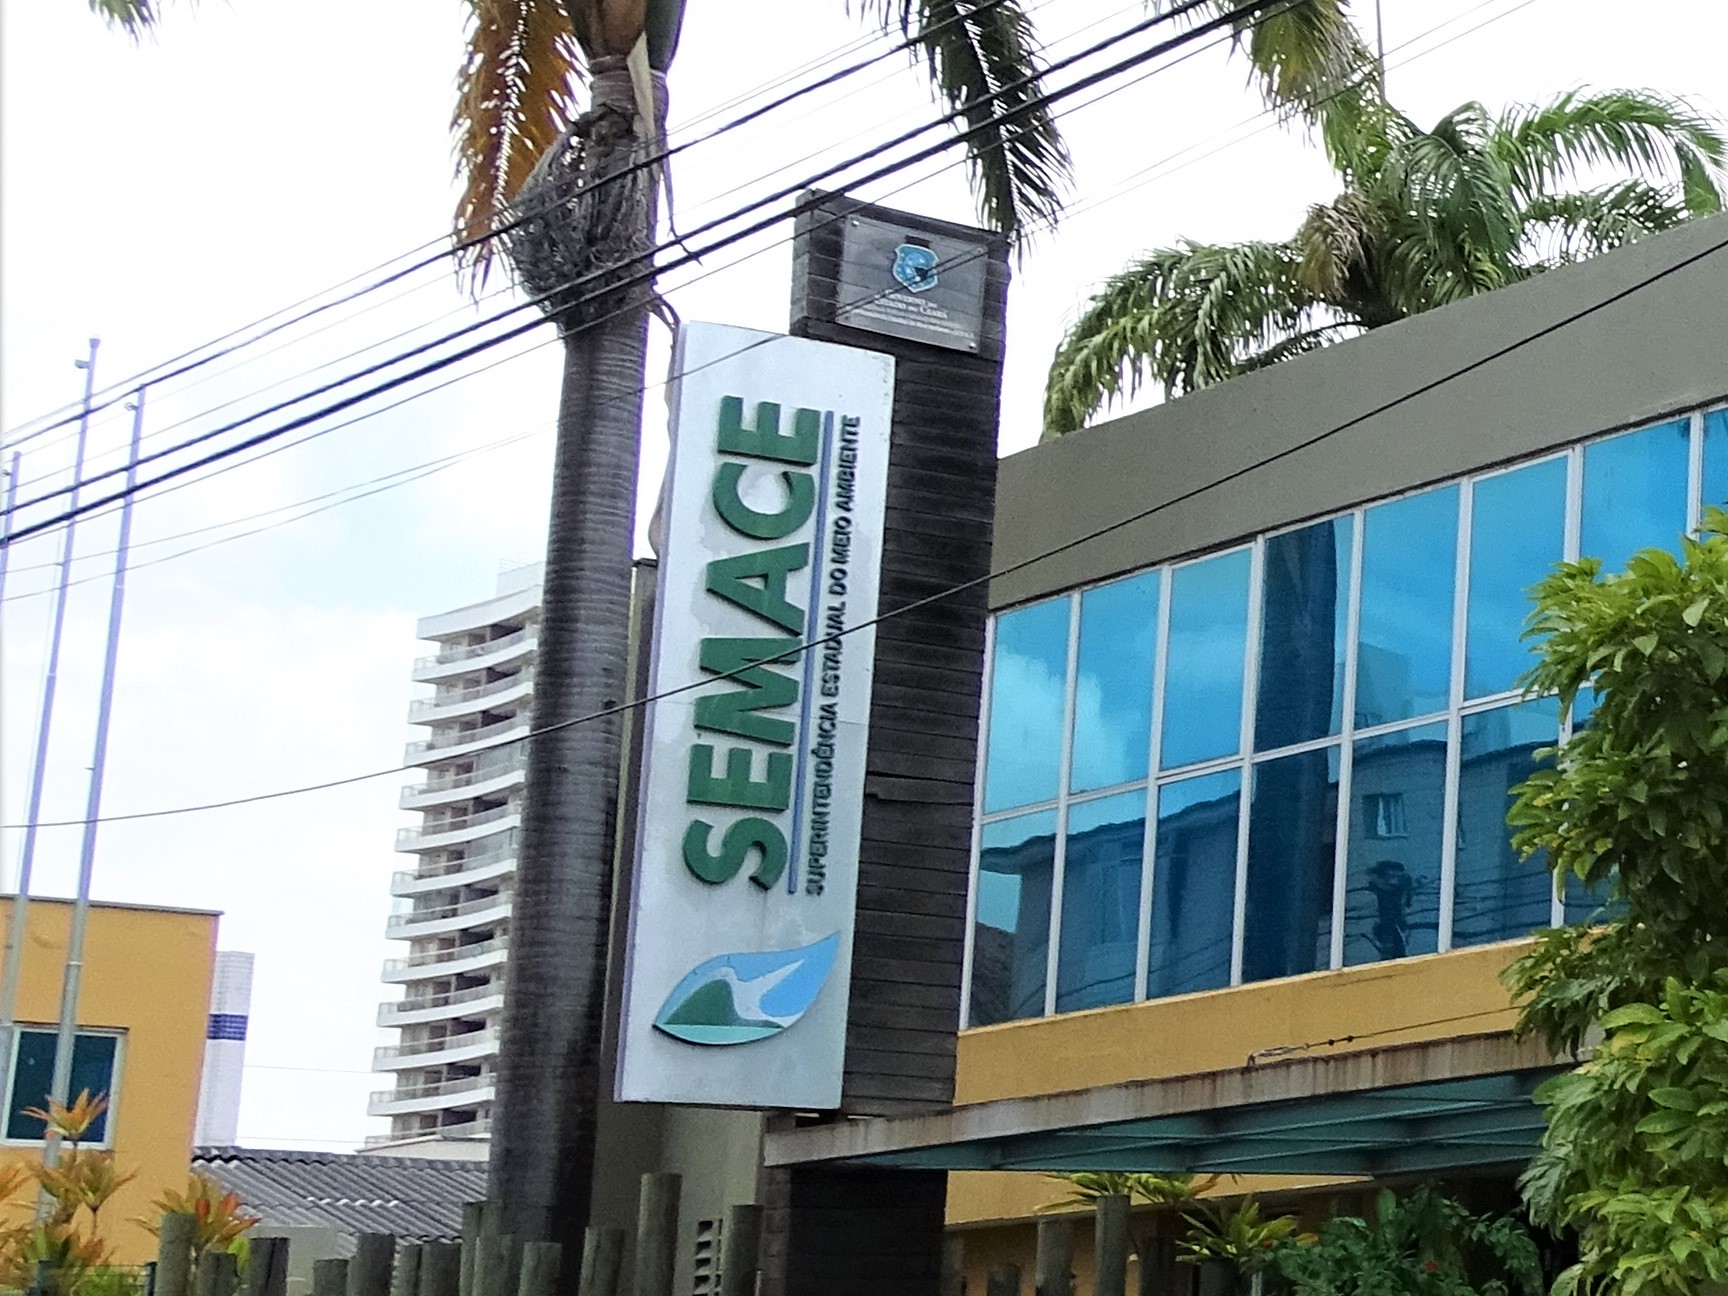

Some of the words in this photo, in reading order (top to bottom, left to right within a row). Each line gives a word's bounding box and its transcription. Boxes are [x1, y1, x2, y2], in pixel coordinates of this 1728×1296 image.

[837, 415, 861, 512] AMBIENTE
[828, 569, 848, 596] DO
[830, 516, 852, 565] MEIO
[683, 395, 821, 892] SEMACE
[820, 601, 845, 697] ESTADUAL
[806, 702, 837, 896] SUPERINTENDÊNCIA
